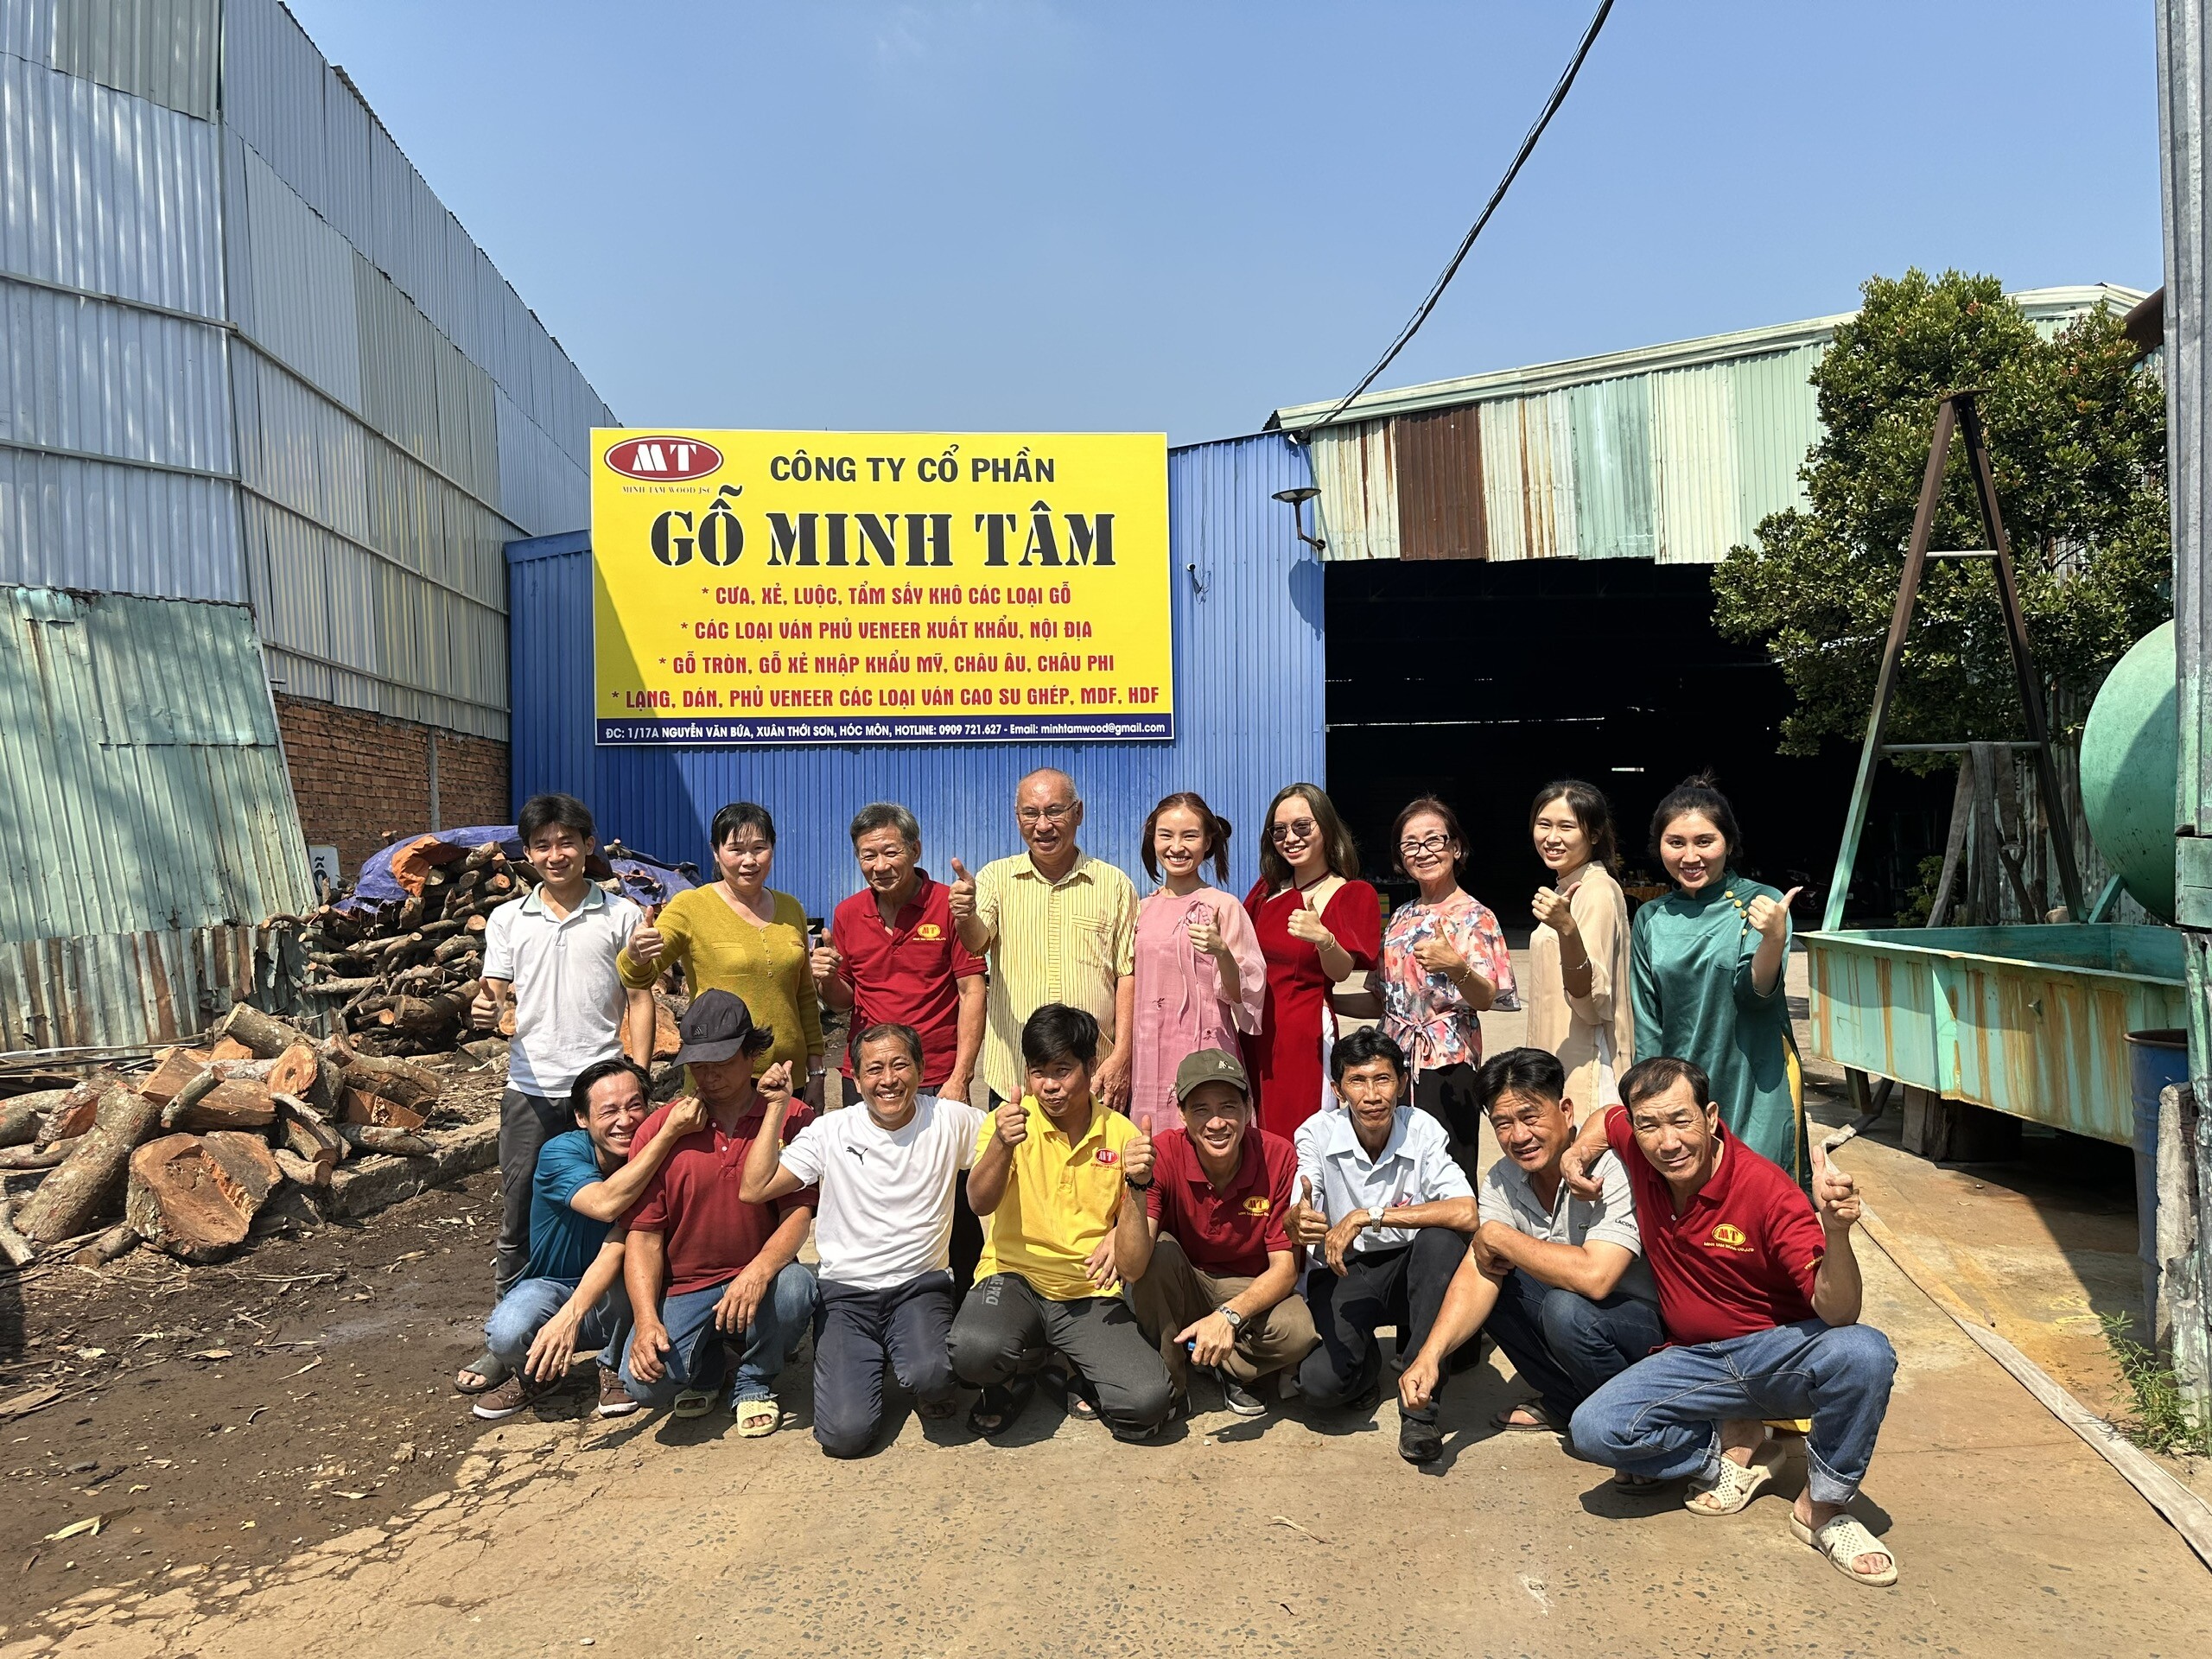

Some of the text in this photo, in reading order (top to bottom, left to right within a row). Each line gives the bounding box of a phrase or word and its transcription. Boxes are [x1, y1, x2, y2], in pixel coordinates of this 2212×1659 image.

[632, 443, 697, 472] MT
[770, 443, 1054, 483] CÔNG TY CỔ PHẦN
[651, 484, 1116, 567] GỖ MINH TÂM
[715, 581, 1071, 608] CƯA, XẺ, LUỘC, TẨM SẤY KHÔ CÁC LOẠI GỖ
[695, 613, 1092, 643] CÁC LOẠI VÁN PHỦ VENEER XUẤT KHẨU, NỘI ĐỊA
[673, 649, 1114, 677] GỖ TRÒN, GỖ XẺ NHẬP KHẨU MỸ, CHÂU ÂU, CHÂU PHI
[626, 683, 1159, 712] LẠNG, DÁN, PHỦ VENEER CÁC LOẠI VÁN CAO SU GHÉP, MDF, HDF
[606, 728, 625, 739] ĐC:
[628, 727, 659, 739] 1/17A
[662, 722, 703, 738] NGUYỄN
[706, 724, 728, 738] VĂN
[730, 723, 754, 740] BỨA,
[756, 724, 785, 738] XUÂN
[787, 723, 810, 737] THỚI
[813, 724, 837, 738] SƠN,
[839, 723, 863, 736] HÓC
[866, 723, 893, 738] MÔN,
[894, 725, 937, 736] HOTLINE:
[939, 724, 963, 735] 0909
[964, 724, 1001, 735] 721.627
[1010, 724, 1039, 734] Email:
[1041, 722, 1166, 736] minhtamwood@gmail.com
